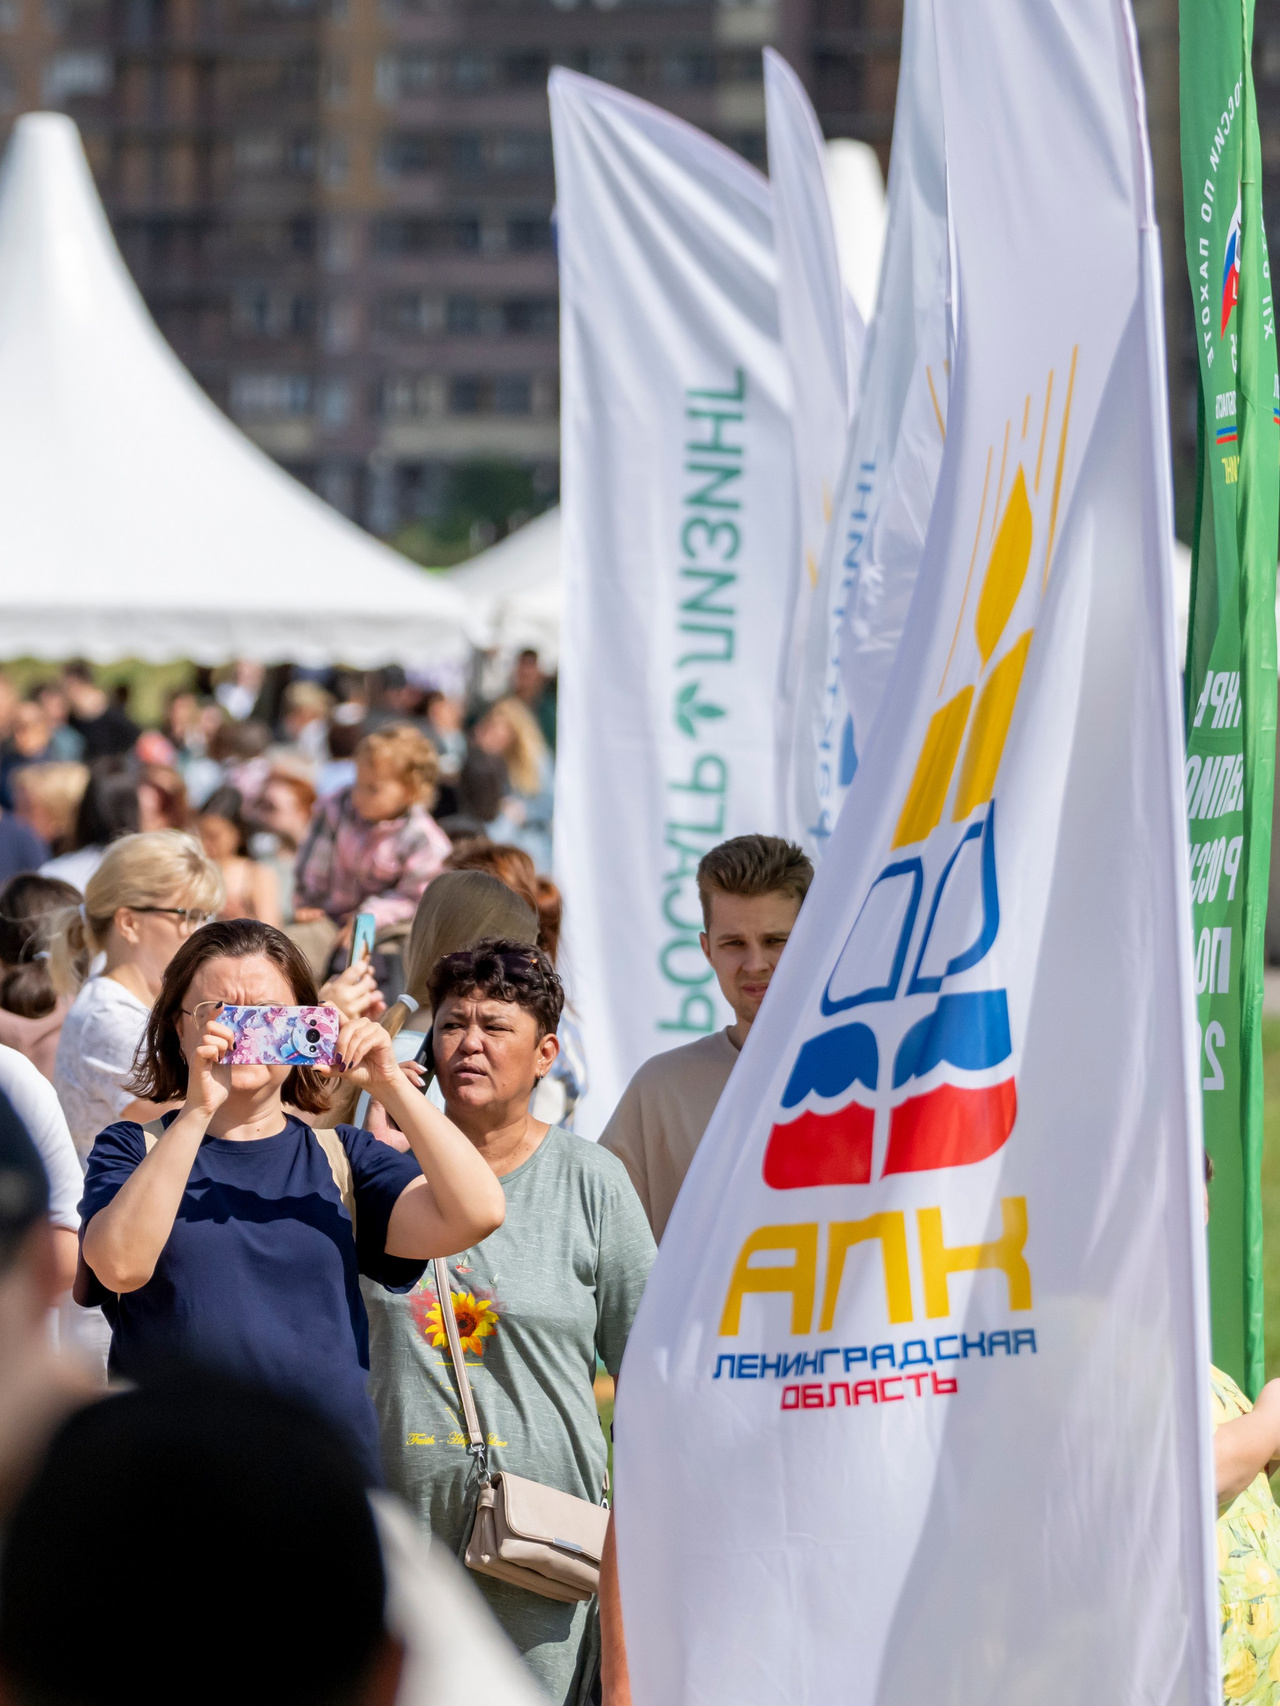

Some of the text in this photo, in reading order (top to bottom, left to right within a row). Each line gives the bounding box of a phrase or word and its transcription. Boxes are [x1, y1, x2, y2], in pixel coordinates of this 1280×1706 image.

[718, 1196, 1033, 1336] АПК
[713, 1328, 1037, 1380] ЛЕНИНГРАДСКАЯ
[780, 1371, 958, 1411] ОБЛАСТЬ
[406, 1432, 435, 1446] Faith
